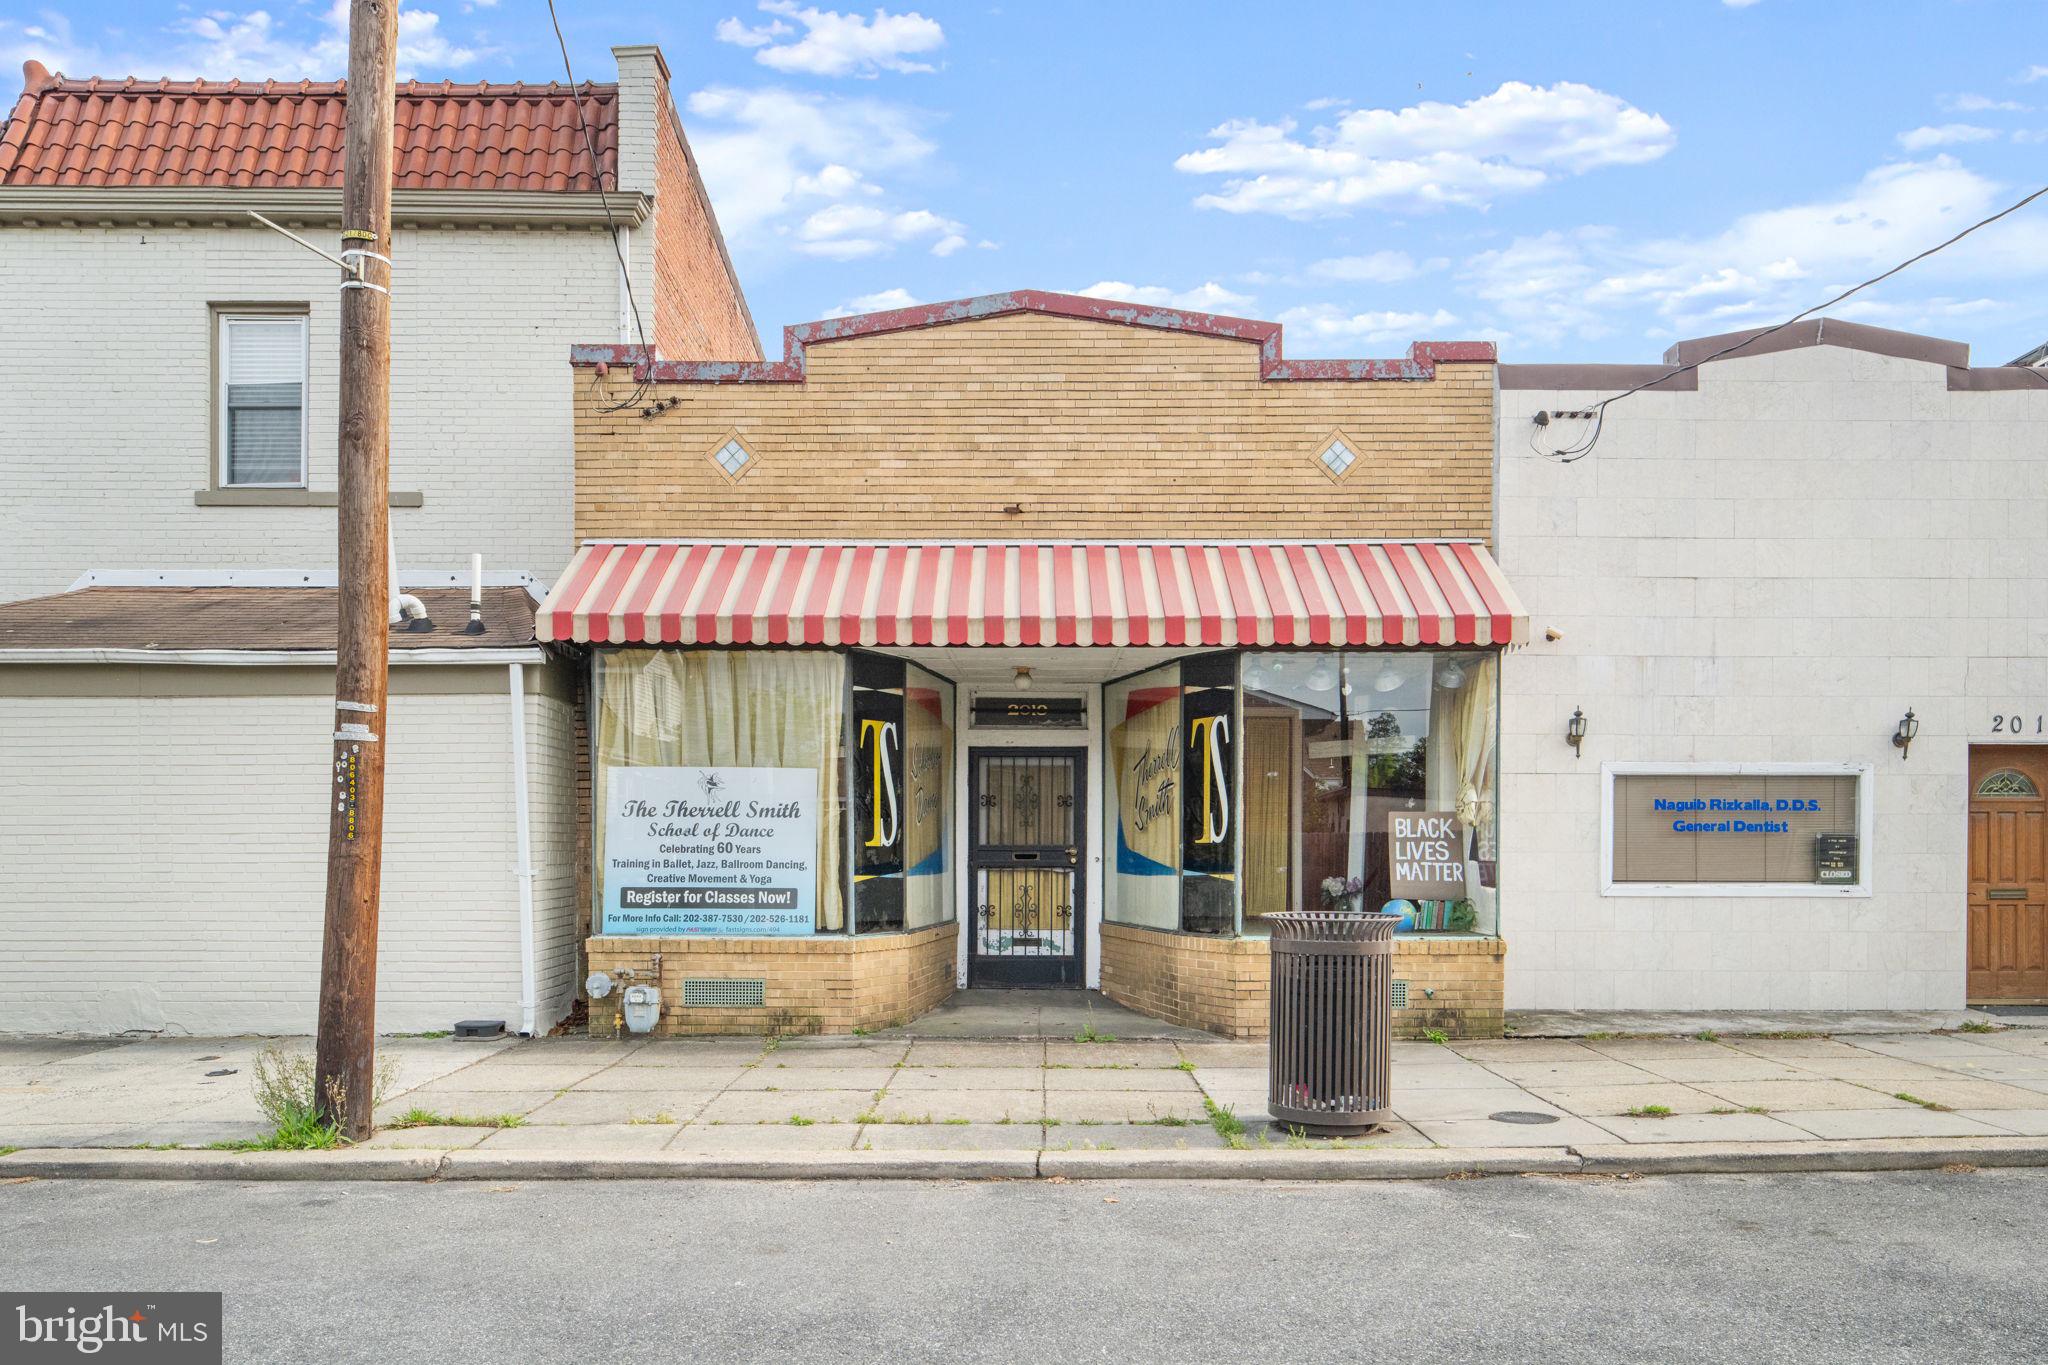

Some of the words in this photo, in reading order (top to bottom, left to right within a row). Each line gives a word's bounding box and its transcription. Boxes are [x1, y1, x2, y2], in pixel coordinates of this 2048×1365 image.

[621, 799, 658, 818] The
[662, 799, 741, 818] Therrell
[746, 800, 801, 819] Smith
[1134, 777, 1175, 832] Smith
[1654, 798, 1706, 812] Naguib
[1709, 799, 1773, 812] Rizkalla,
[1776, 799, 1822, 812] D.D.S.
[647, 821, 700, 837] School
[703, 822, 721, 841] of
[725, 822, 774, 838] Dance
[1395, 817, 1456, 839] BLACK
[1673, 820, 1730, 833] General
[1733, 820, 1788, 833] Dentist
[659, 844, 715, 855] Celebrating
[717, 841, 733, 854] 60
[735, 844, 762, 854] Years
[1396, 840, 1450, 861] LIVES
[612, 859, 650, 870] Training
[652, 859, 661, 868] in
[663, 859, 694, 870] Ballet,
[696, 860, 718, 870] Jazz,
[721, 860, 763, 869] Ballroom
[766, 860, 807, 871] Dancing,
[1396, 861, 1464, 881] MATTER
[647, 873, 686, 883] Creative
[688, 874, 737, 884] Movement
[740, 874, 748, 884] &
[749, 874, 772, 886] Yoga
[626, 890, 681, 906] Register
[683, 890, 702, 903] for
[705, 890, 755, 904] Classes
[758, 891, 791, 904] Now!
[608, 914, 621, 923] For
[622, 914, 643, 923] More
[645, 914, 660, 923] Info
[663, 914, 681, 923] Call:
[650, 925, 676, 933] provided
[677, 925, 686, 933] by
